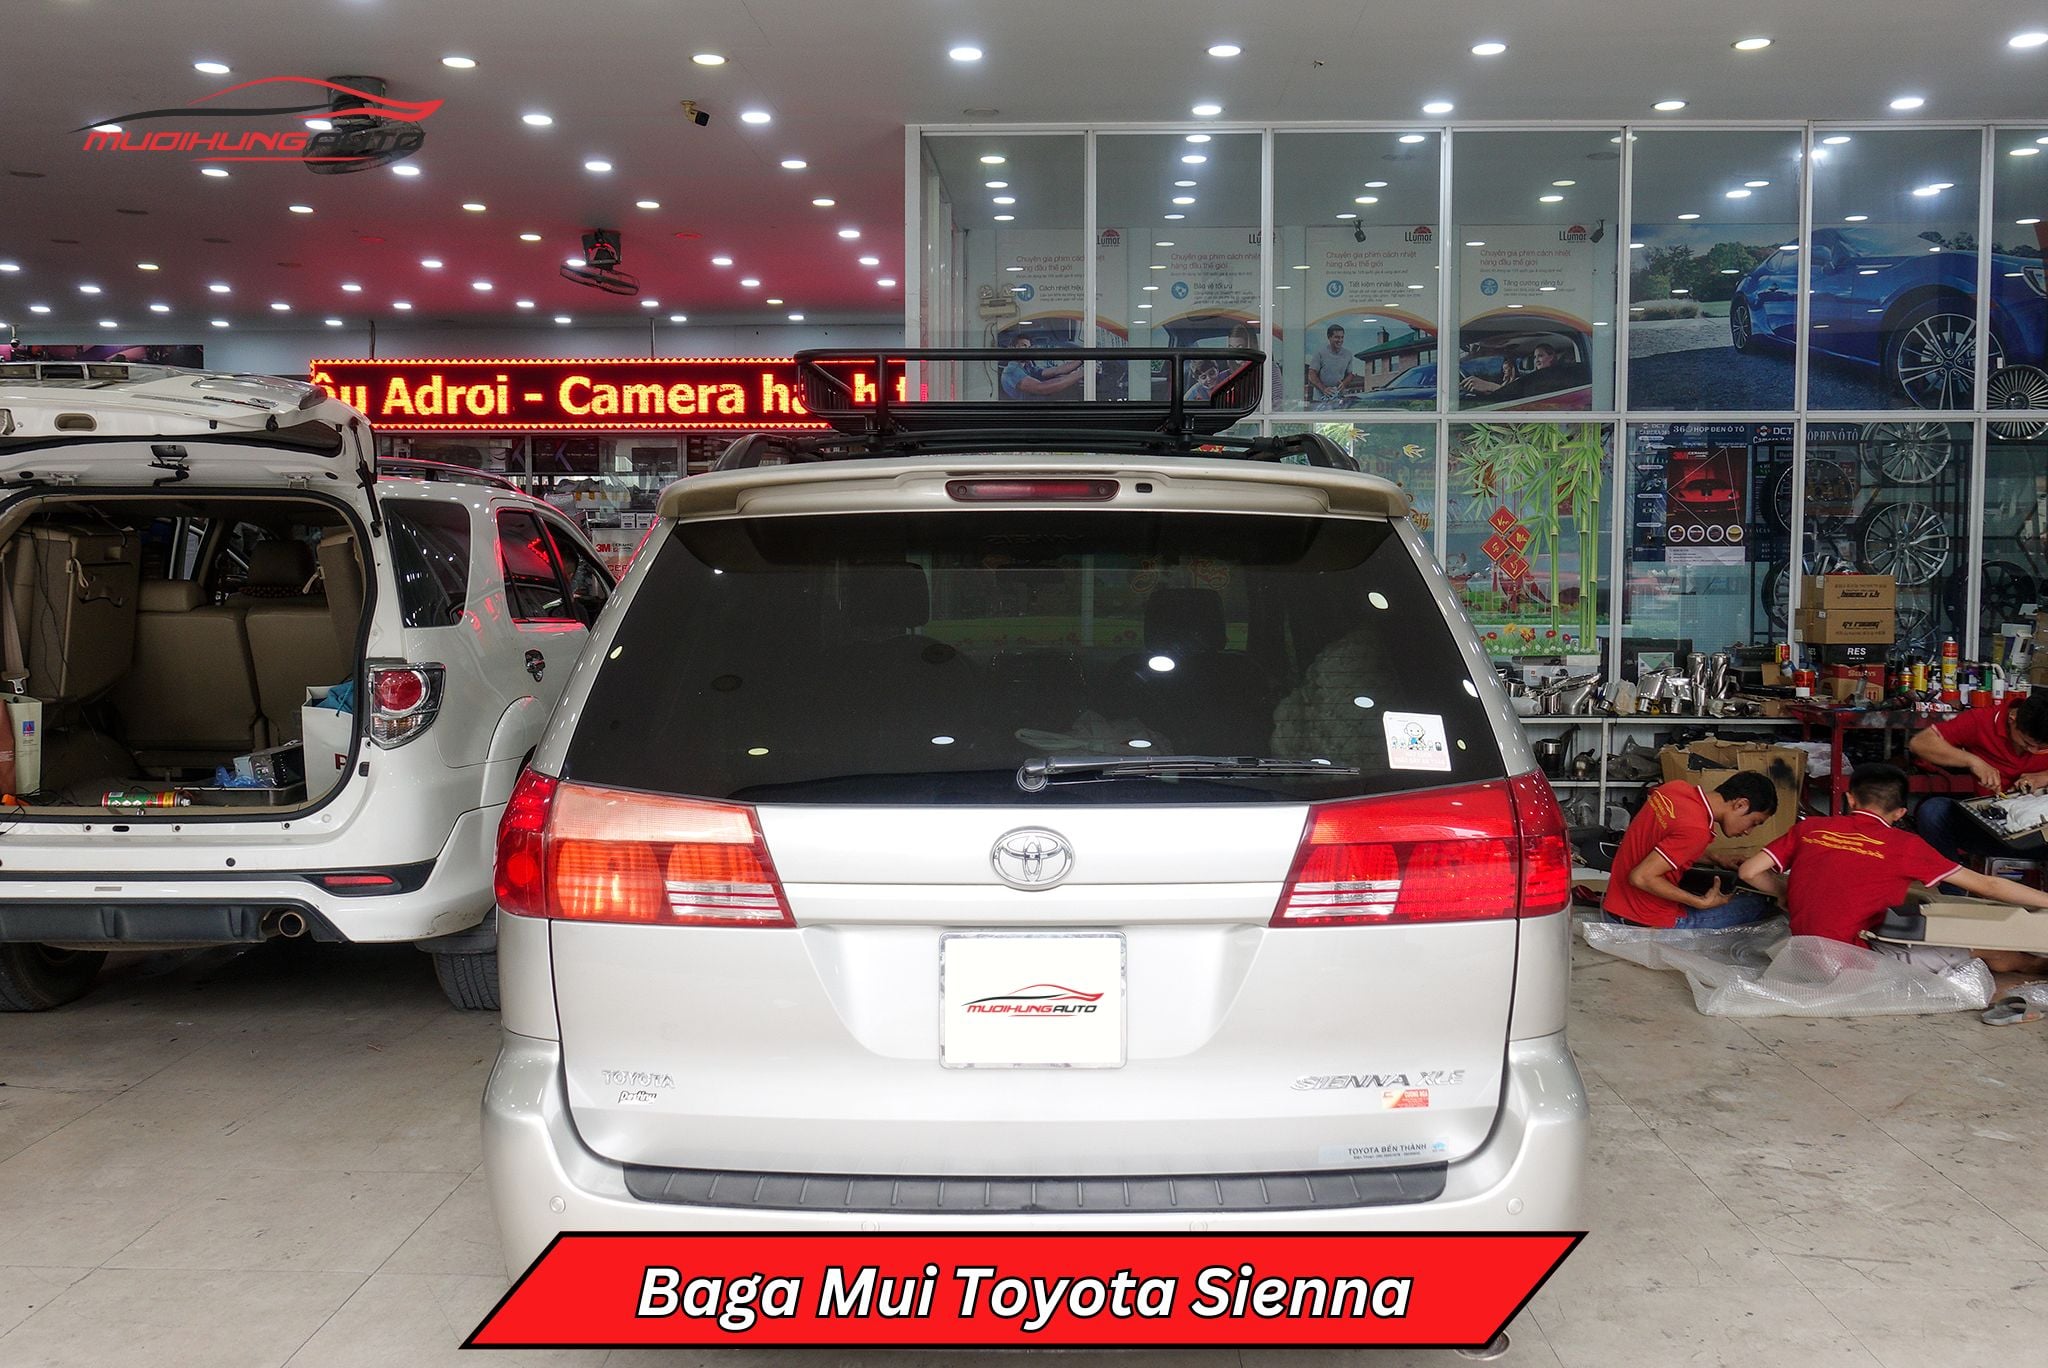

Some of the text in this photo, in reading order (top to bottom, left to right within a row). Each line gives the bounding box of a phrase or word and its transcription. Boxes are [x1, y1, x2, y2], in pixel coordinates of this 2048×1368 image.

[382, 375, 509, 416] Adroi
[558, 375, 746, 416] Camera
[595, 543, 611, 553] 3M
[1847, 647, 1867, 656] RES
[602, 1070, 676, 1090] TOYOTA
[1290, 1069, 1465, 1091] SIENNA XLE
[1348, 1146, 1380, 1155] TOYOTA
